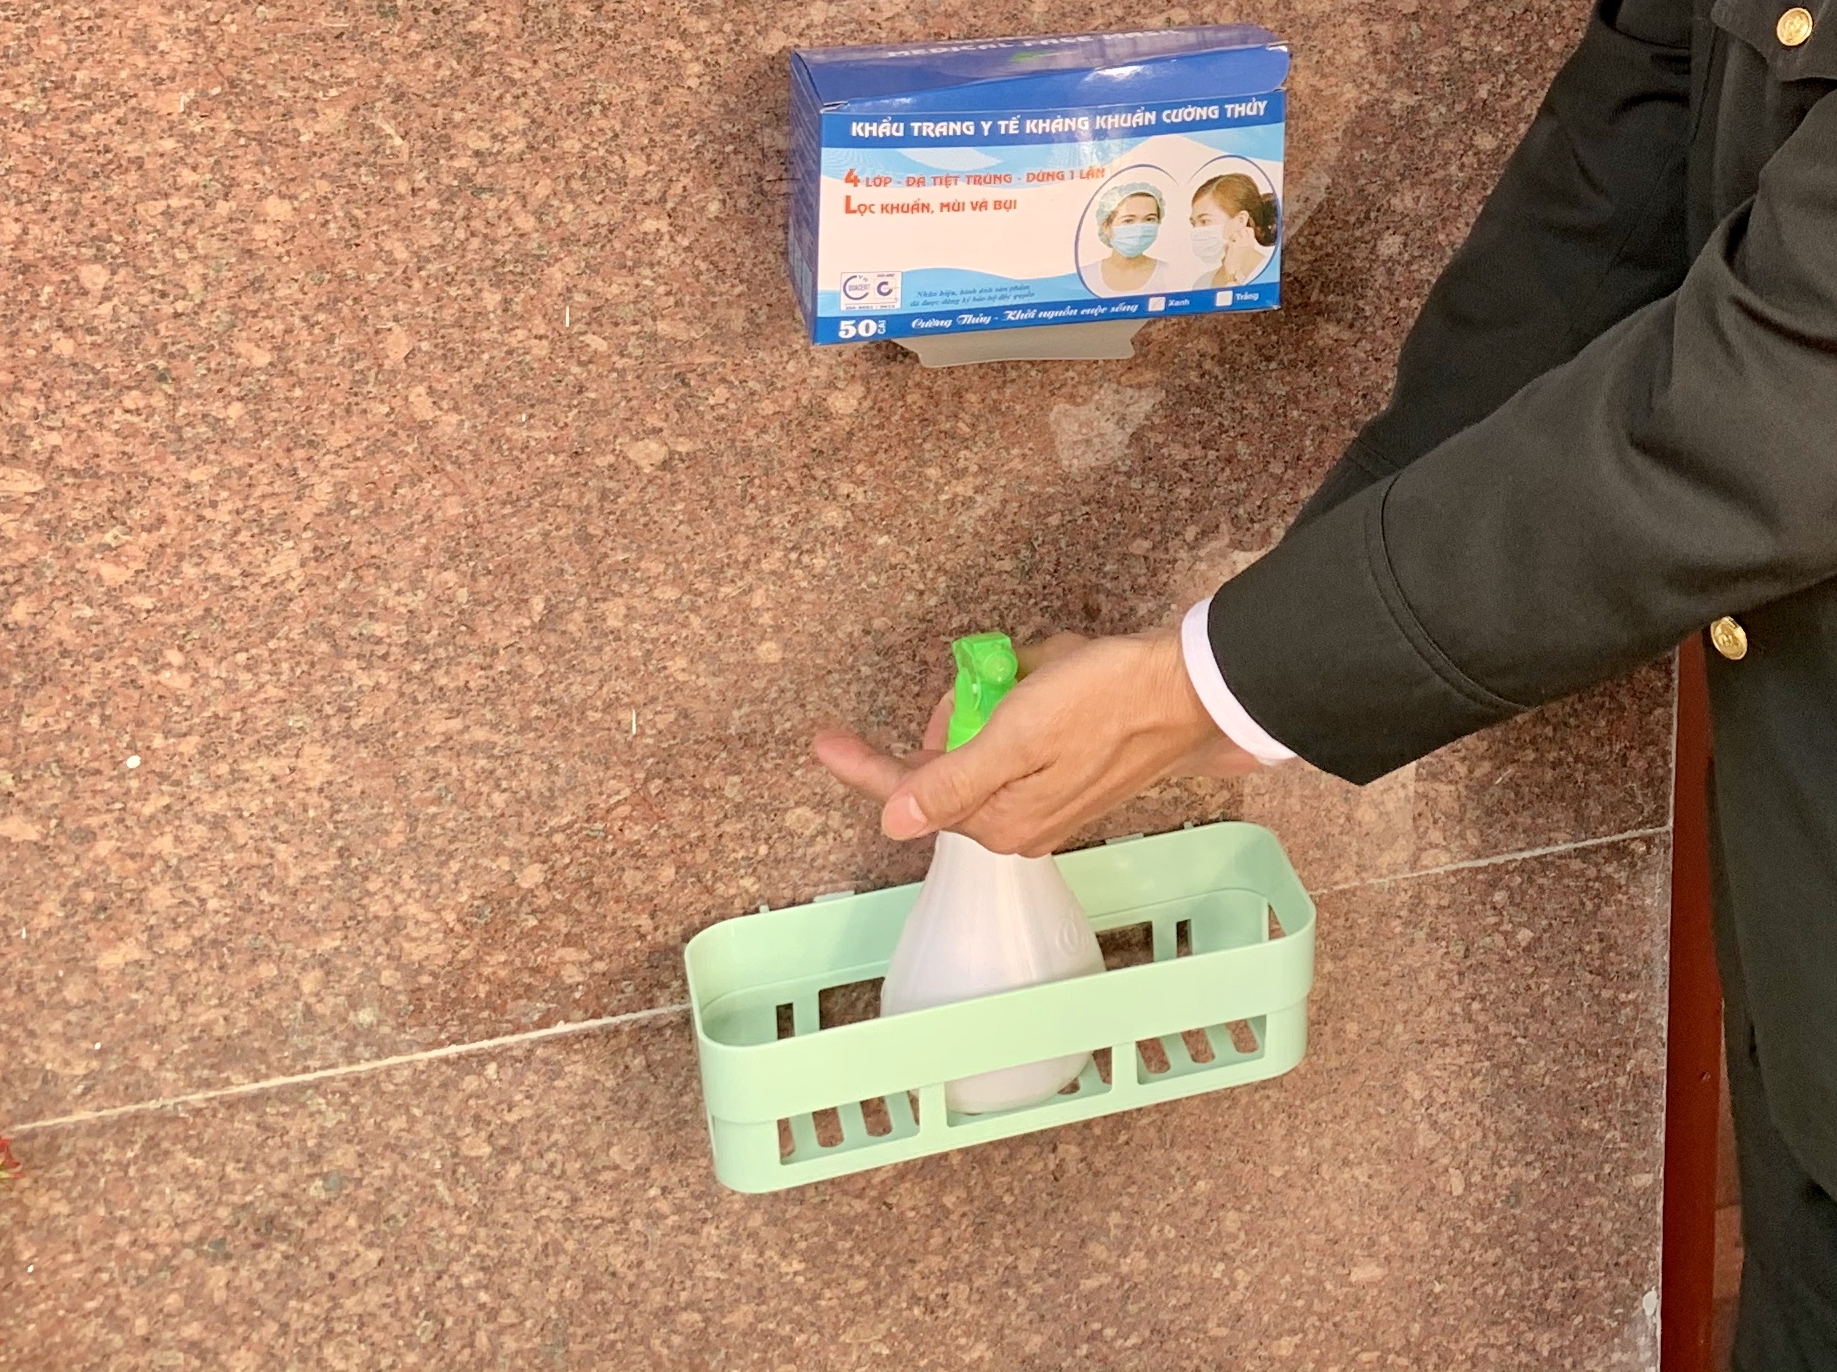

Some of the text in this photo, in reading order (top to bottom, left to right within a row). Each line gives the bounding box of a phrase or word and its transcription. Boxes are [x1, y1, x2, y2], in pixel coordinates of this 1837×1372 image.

[851, 98, 1268, 138] KHẨU TRANG Y TẾ KHÁNG KHUẨN CƯỜNG THỦY
[844, 168, 860, 187] 4
[838, 319, 877, 338] 50
